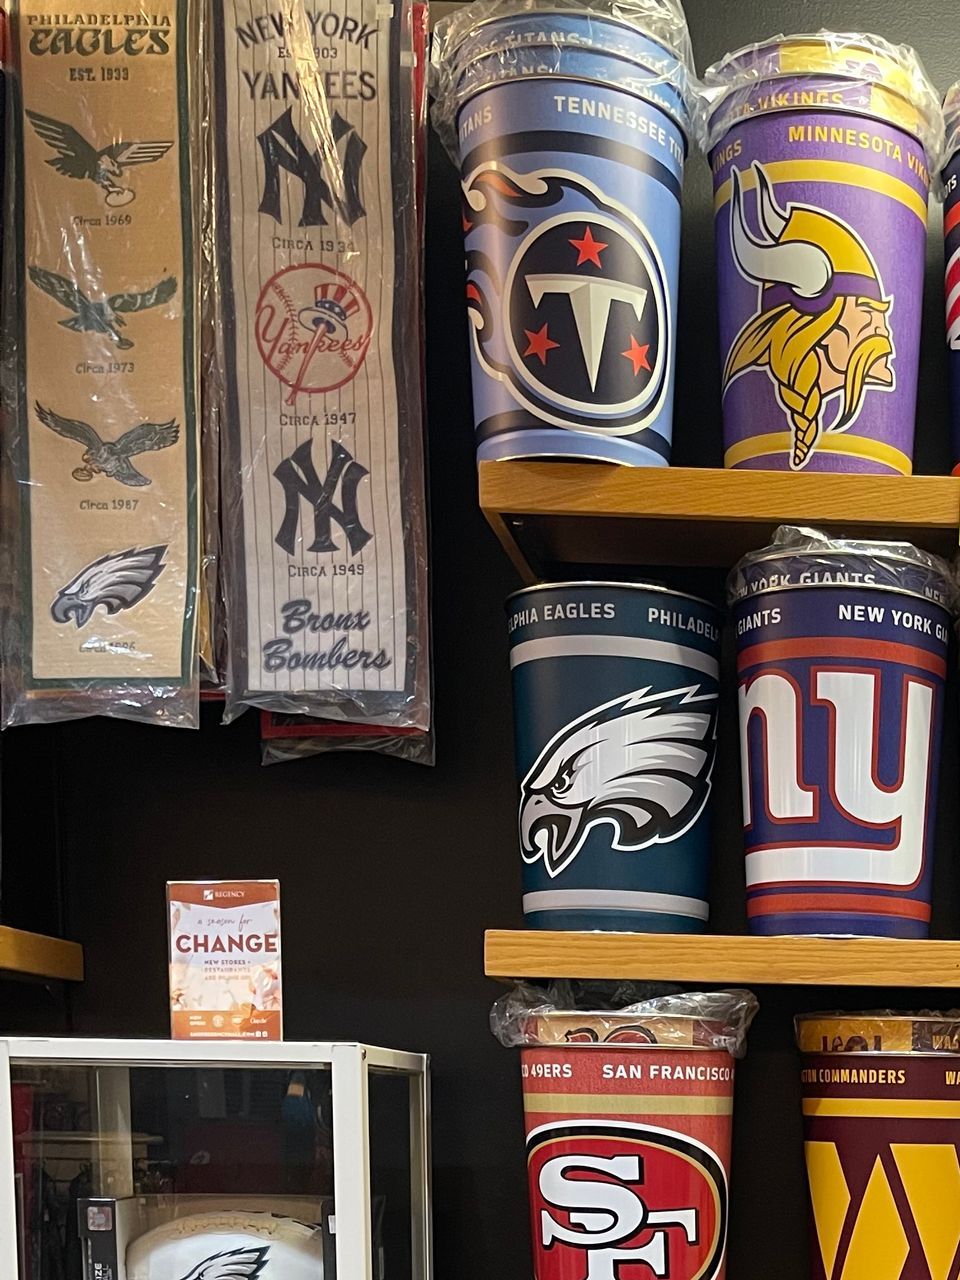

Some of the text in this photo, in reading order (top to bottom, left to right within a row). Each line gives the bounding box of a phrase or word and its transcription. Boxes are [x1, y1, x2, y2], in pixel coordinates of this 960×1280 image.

[27, 13, 172, 27] PHILADELPHIA
[307, 12, 378, 49] YORK
[29, 27, 172, 56] EAGLES
[69, 67, 129, 81] EST. 1933
[241, 71, 376, 101] YANEES
[554, 95, 665, 146] TENNESSEE
[788, 126, 902, 162] MINNESOTA
[105, 215, 132, 226] 1969
[258, 304, 370, 357] Yankees
[107, 362, 135, 374] 1973
[323, 412, 357, 426] 1947
[80, 499, 138, 511] Circa 1987
[273, 438, 374, 556] NY
[333, 563, 365, 577] 1949
[280, 600, 371, 634] Bronx
[544, 603, 616, 621] EAGLES
[738, 604, 931, 635] GIANTS NEW YORK
[262, 638, 392, 672] Bombers
[175, 934, 278, 953] CHANGE
[531, 1063, 729, 1081] 49ERS SAN FRANCISCO
[819, 1069, 905, 1084] COMMANDERS
